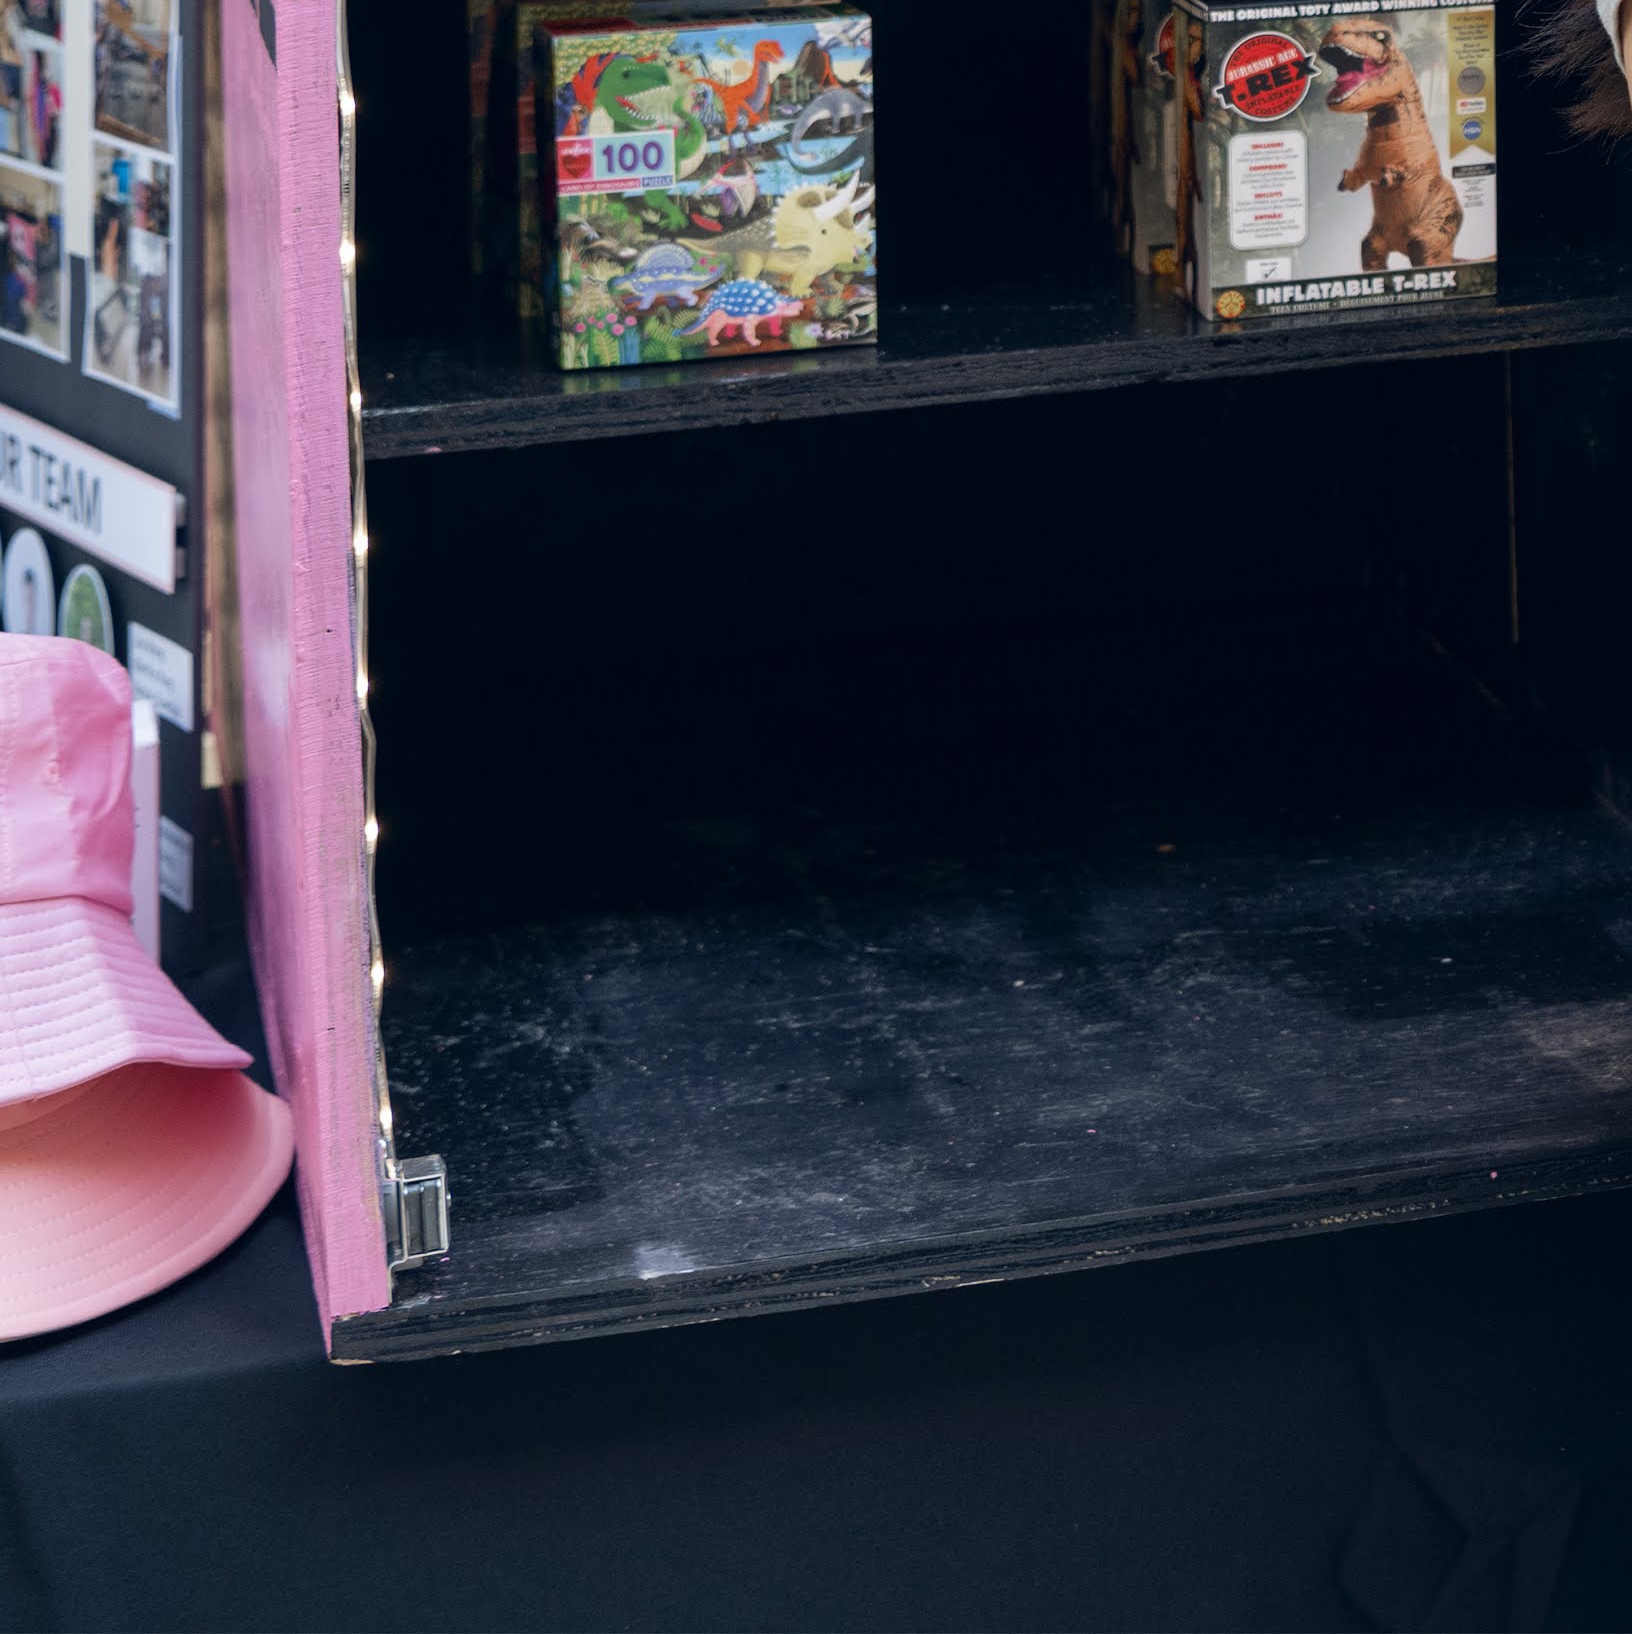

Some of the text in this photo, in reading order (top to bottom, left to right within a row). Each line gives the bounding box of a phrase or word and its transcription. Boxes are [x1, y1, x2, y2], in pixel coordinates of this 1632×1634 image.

[1210, 11, 1236, 22] THE
[1239, 7, 1297, 21] ORIGINAL
[1298, 4, 1330, 17] TOTY
[1332, 1, 1379, 14] AWARD
[603, 141, 663, 173] 100
[643, 176, 672, 186] PUZZLE
[1256, 278, 1384, 306] INFLATABLE
[1393, 271, 1457, 292] T-REX
[1292, 301, 1331, 312] COSTUME
[1397, 292, 1418, 302] POUR
[28, 443, 103, 534] TEAM
